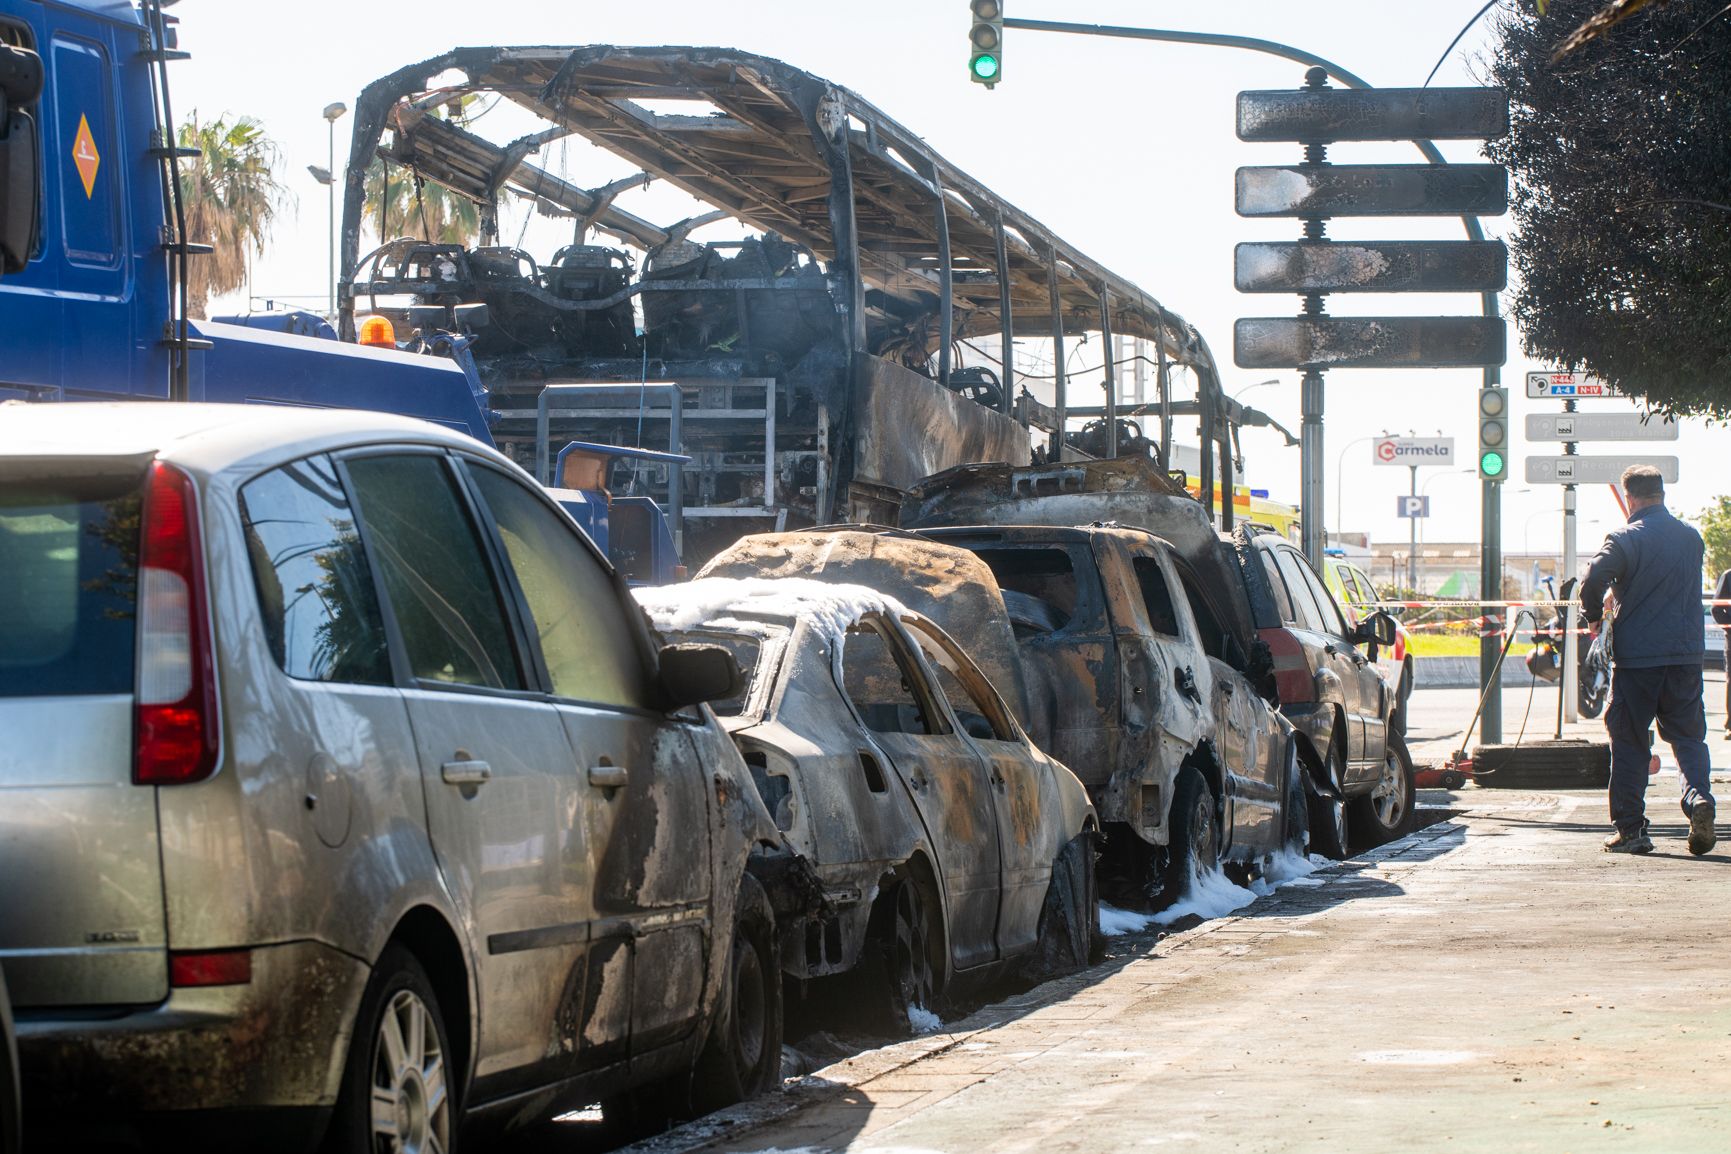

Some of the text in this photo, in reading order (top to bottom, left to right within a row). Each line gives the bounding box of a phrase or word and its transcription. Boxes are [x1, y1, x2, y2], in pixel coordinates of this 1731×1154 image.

[1555, 386, 1599, 394] A-4 N-IV
[1378, 441, 1449, 461] Carmela
[1405, 498, 1422, 516] P
